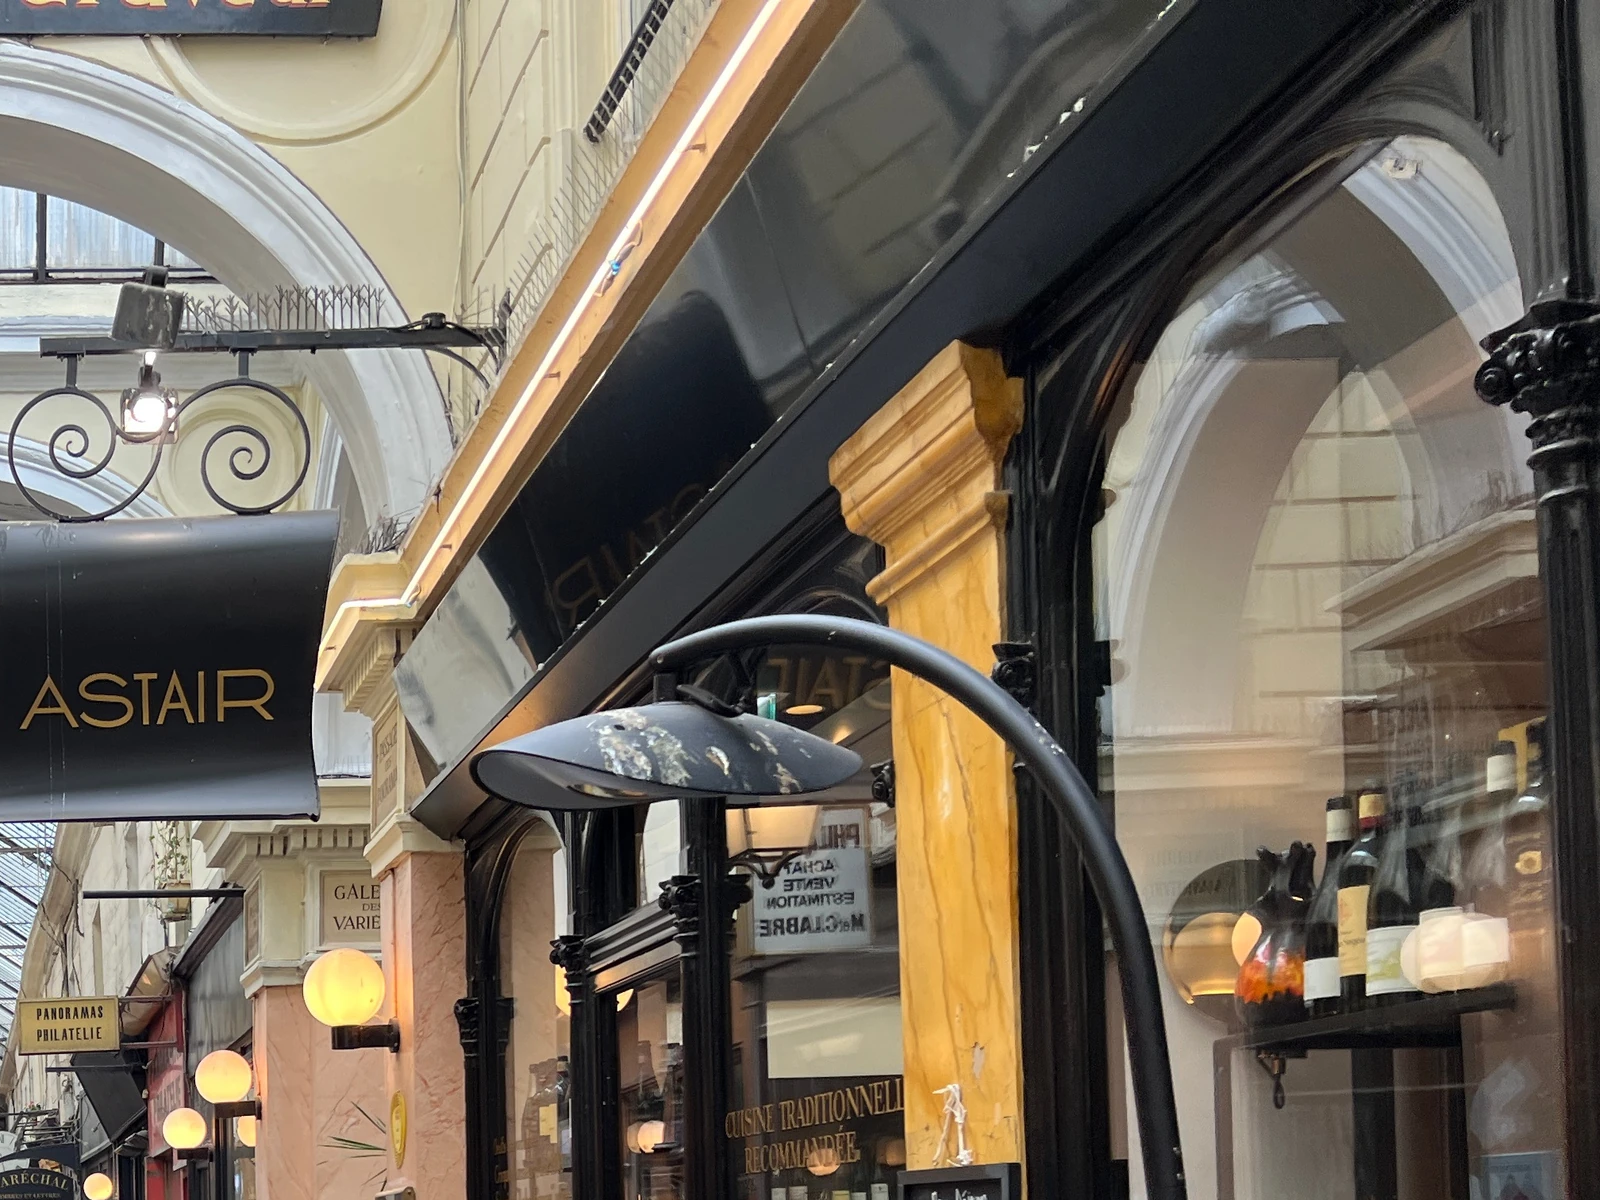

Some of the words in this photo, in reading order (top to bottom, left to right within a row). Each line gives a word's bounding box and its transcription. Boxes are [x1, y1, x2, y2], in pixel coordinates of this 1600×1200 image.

[20, 668, 276, 730] ASTAIR
[334, 884, 380, 900] GALE
[333, 915, 380, 930] VARIÉ
[36, 1005, 104, 1021] PANORAMAS
[36, 1026, 102, 1042] PHILATELIE
[726, 1103, 775, 1139] CUISINE
[779, 1078, 905, 1133] TRADITIONNELL
